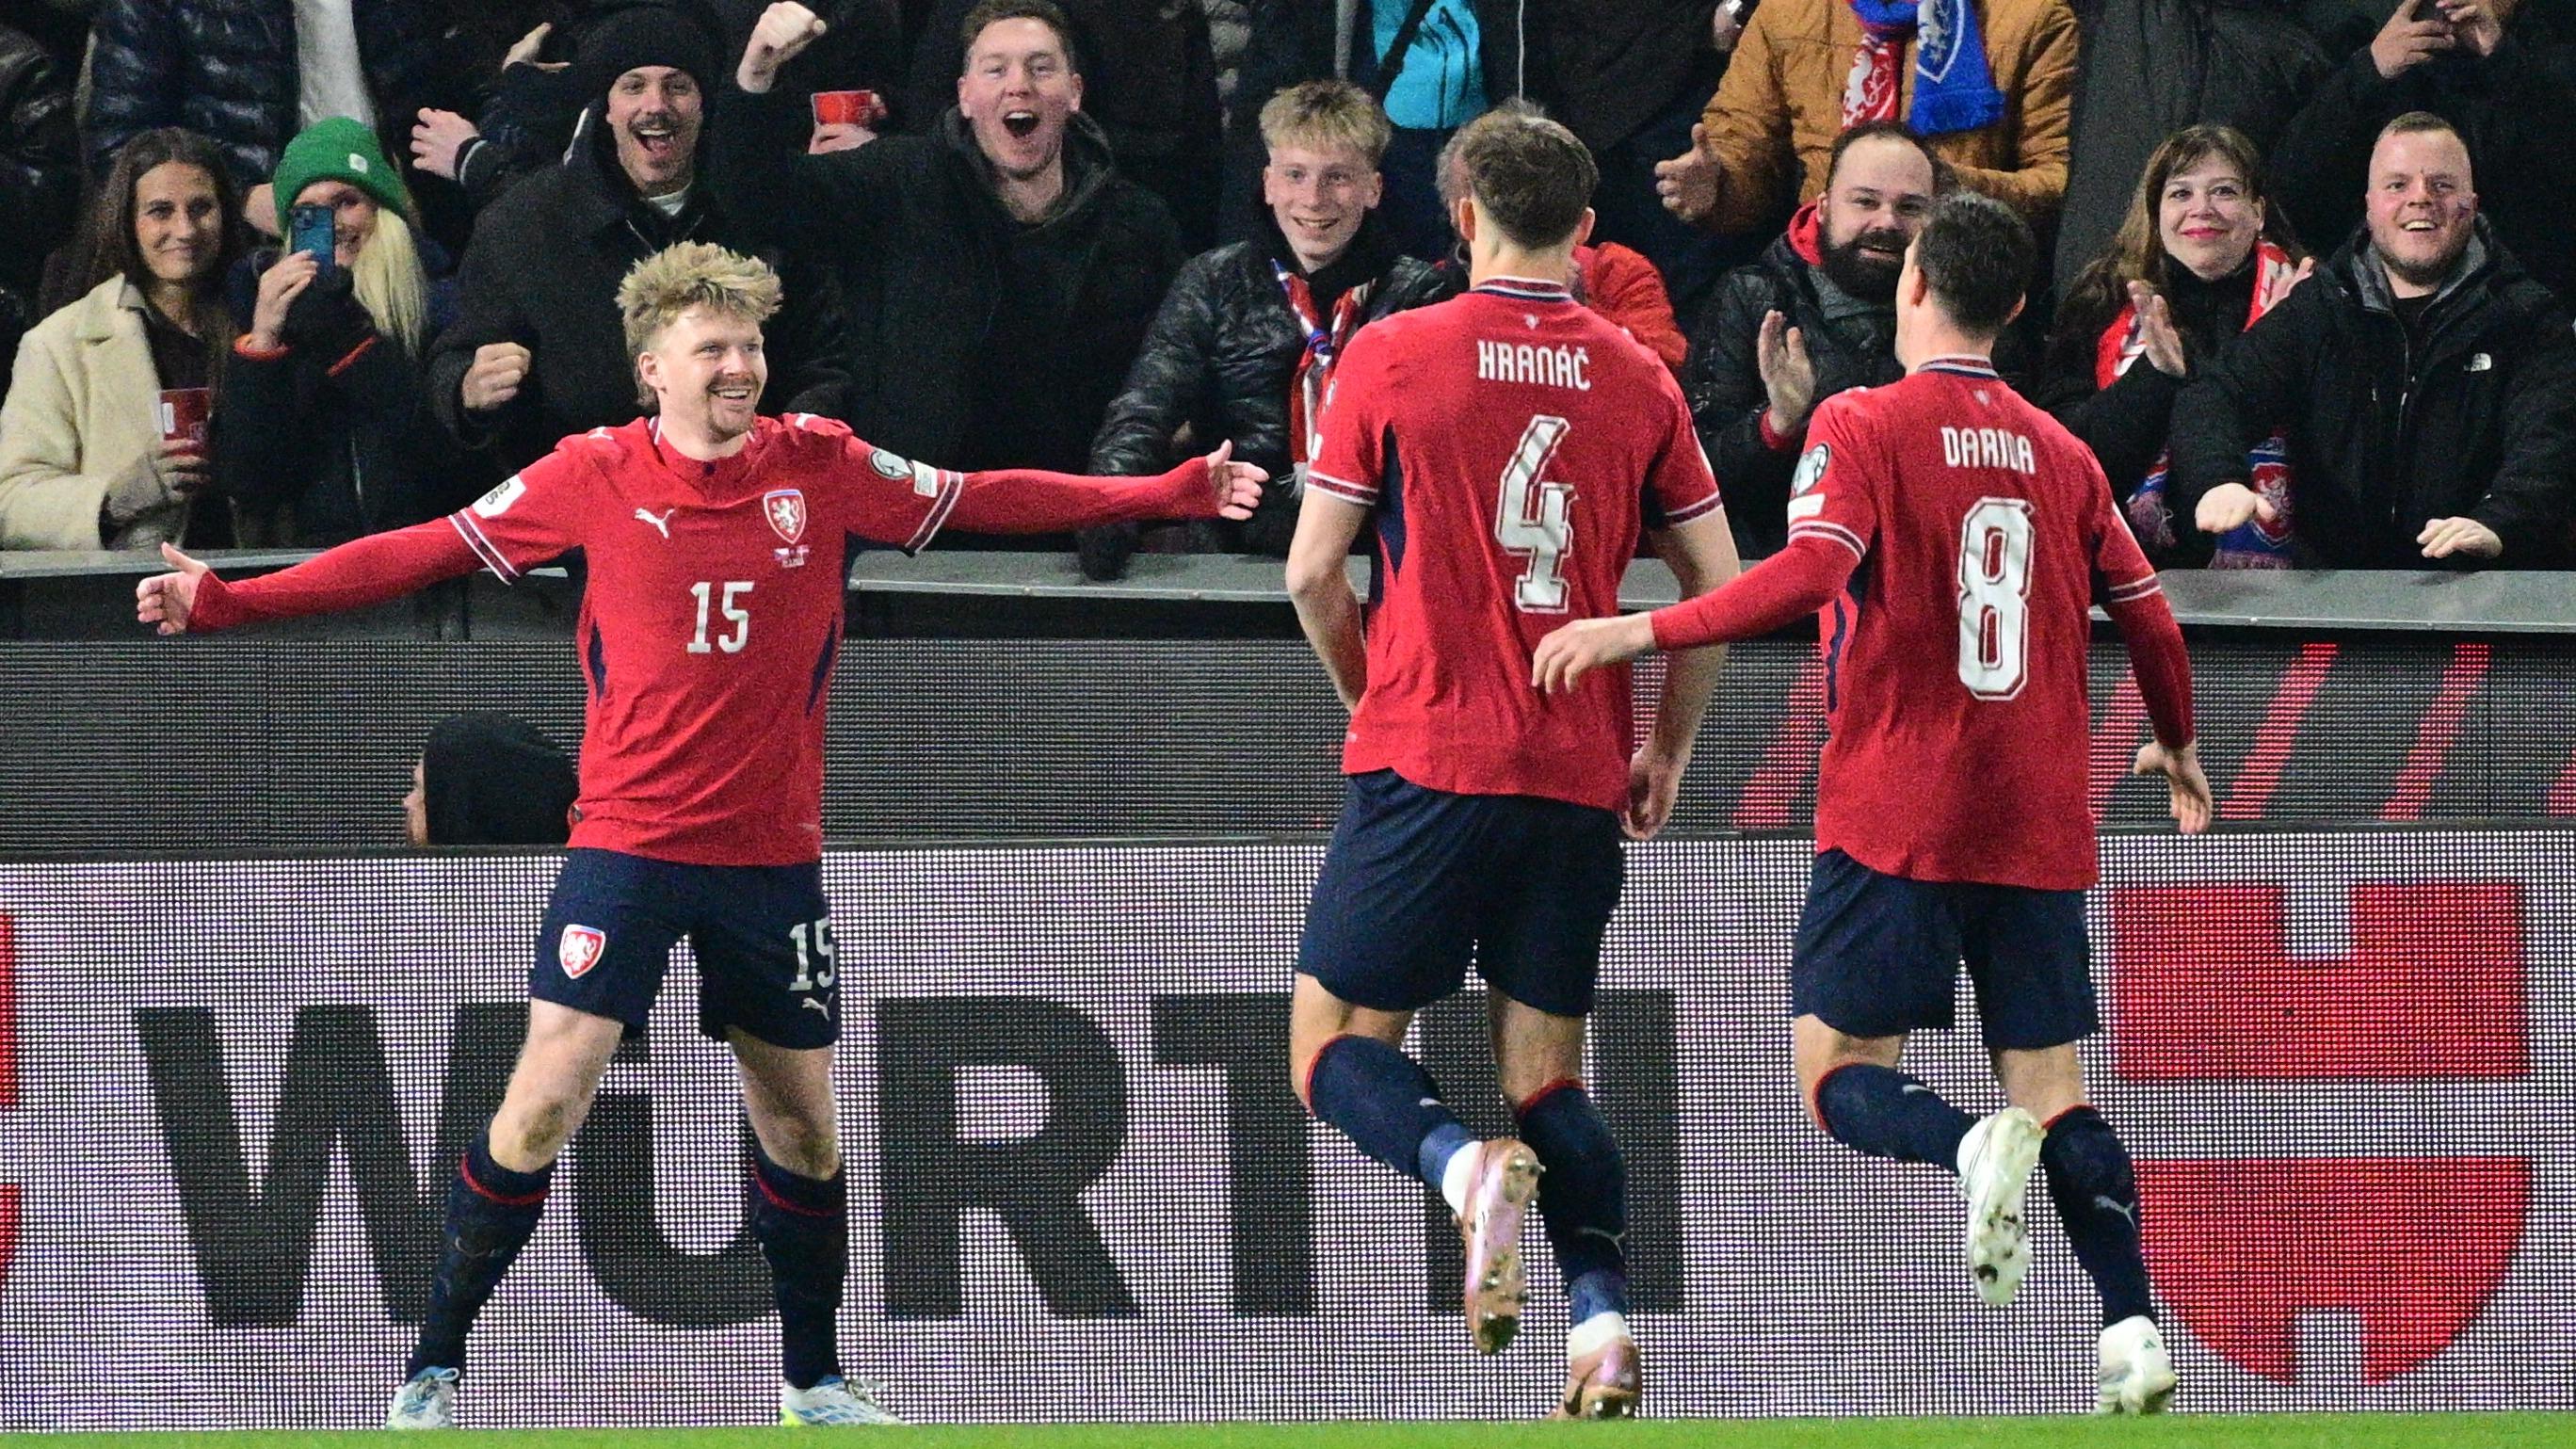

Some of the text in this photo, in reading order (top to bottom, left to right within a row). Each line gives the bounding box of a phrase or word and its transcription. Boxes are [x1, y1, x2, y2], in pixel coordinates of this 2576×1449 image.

[1477, 339, 1591, 391] HRANÁČ
[1495, 413, 1580, 614] 4
[686, 580, 755, 653] 15
[1958, 495, 2036, 701] 8
[789, 916, 835, 991] 15
